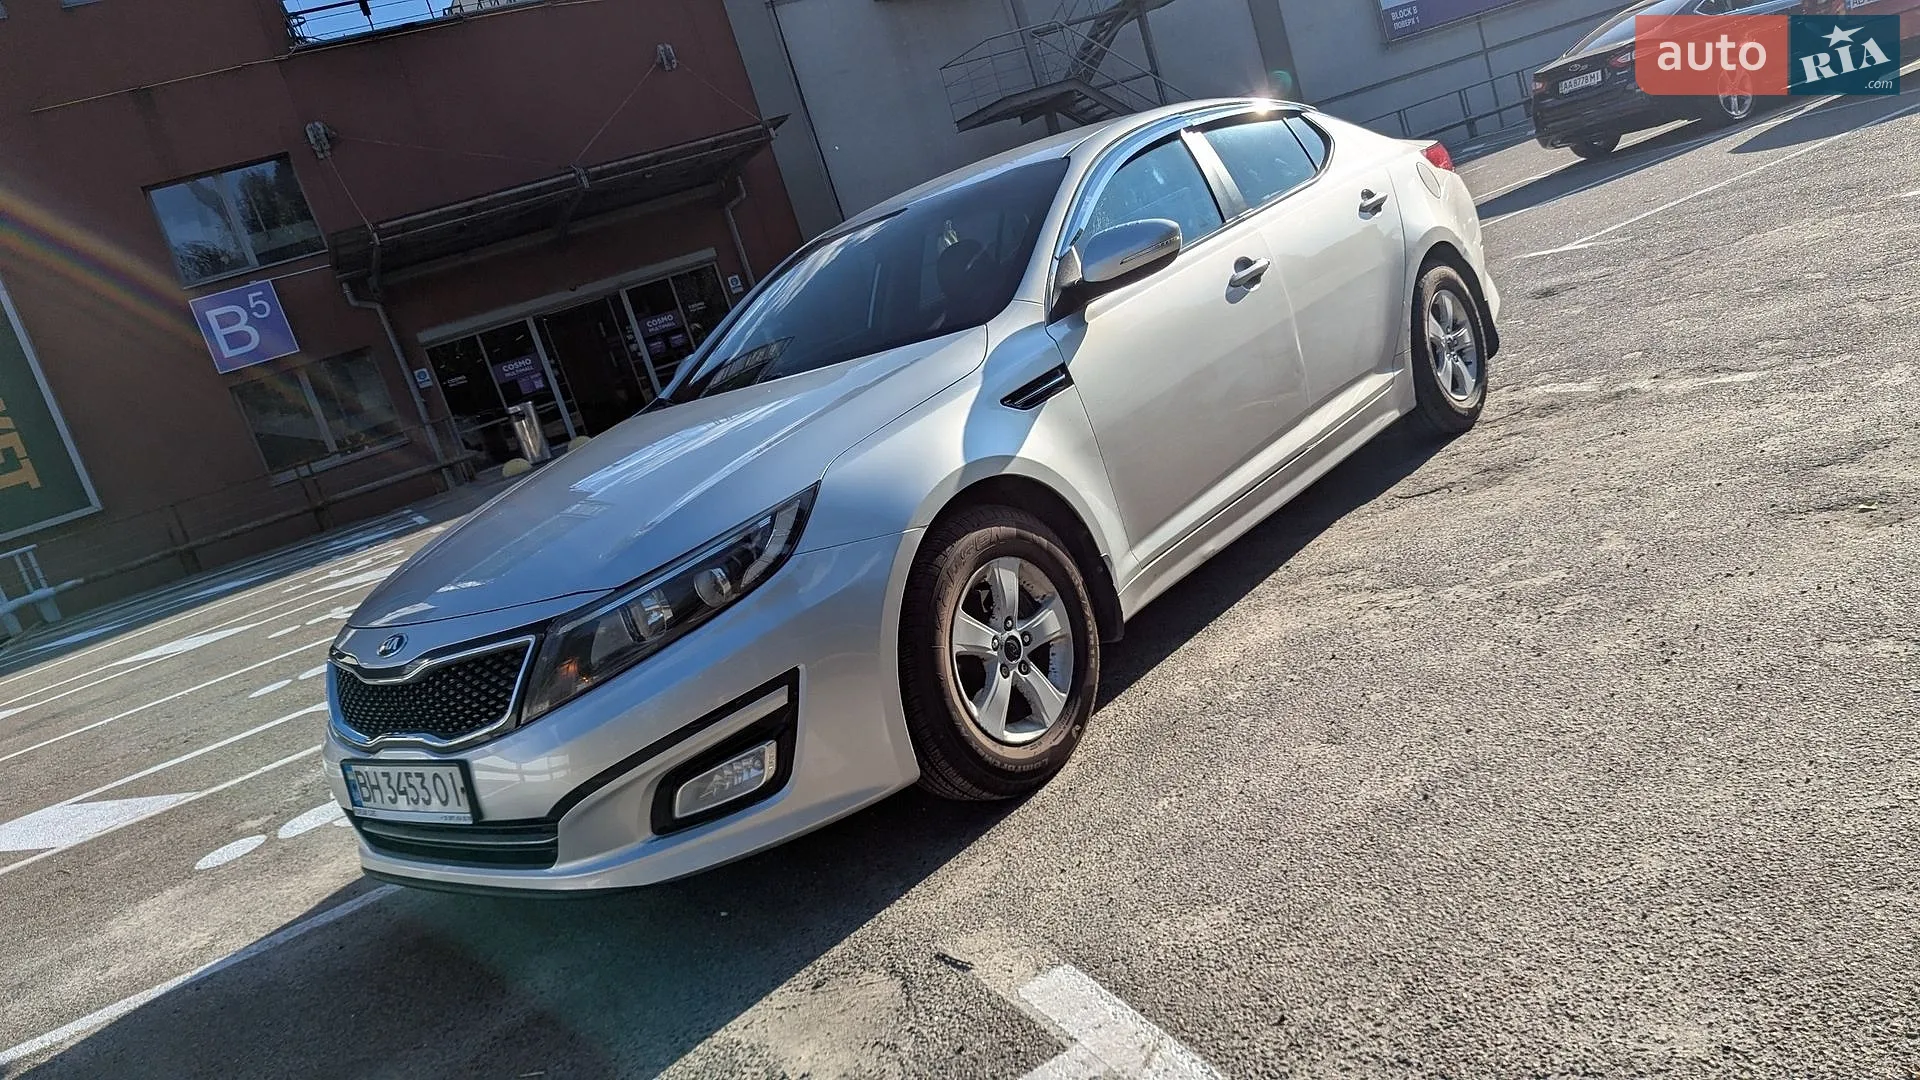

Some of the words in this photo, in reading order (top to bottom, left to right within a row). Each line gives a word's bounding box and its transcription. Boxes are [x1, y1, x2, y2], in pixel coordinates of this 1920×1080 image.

[1391, 7, 1412, 20] BLOCK
[645, 314, 675, 328] COSMO
[502, 358, 532, 372] COSMO
